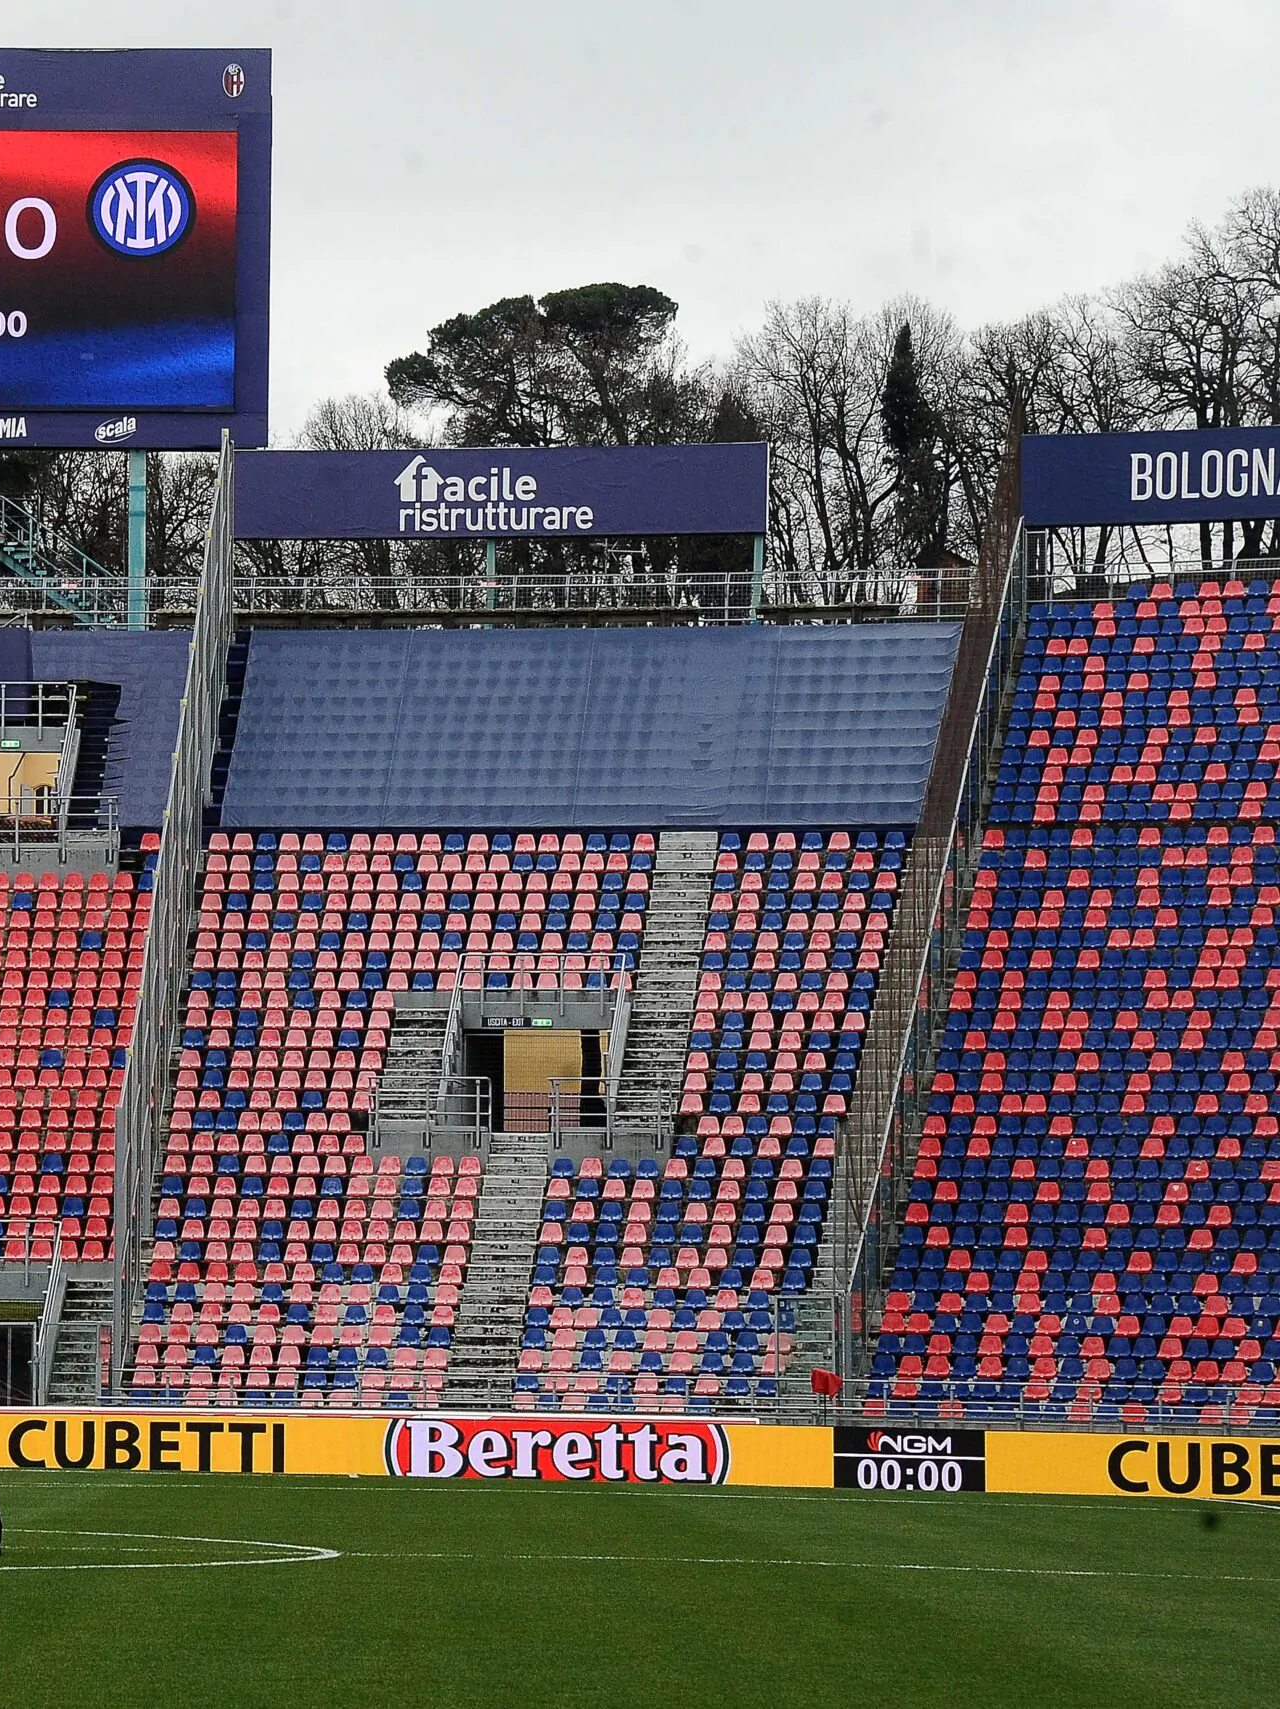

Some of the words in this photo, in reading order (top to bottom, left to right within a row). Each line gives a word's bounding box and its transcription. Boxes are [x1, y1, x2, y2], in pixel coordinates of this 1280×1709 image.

[97, 417, 136, 438] scala
[1131, 447, 1280, 501] BOLOGN
[399, 502, 594, 532] ristrutturare
[488, 1018, 507, 1026] USCITA
[8, 1419, 285, 1473] CUBETTI
[406, 1420, 707, 1481] Beretta
[878, 1435, 952, 1454] NGM
[857, 1459, 962, 1492] 00:00
[1108, 1440, 1280, 1495] CUBE
